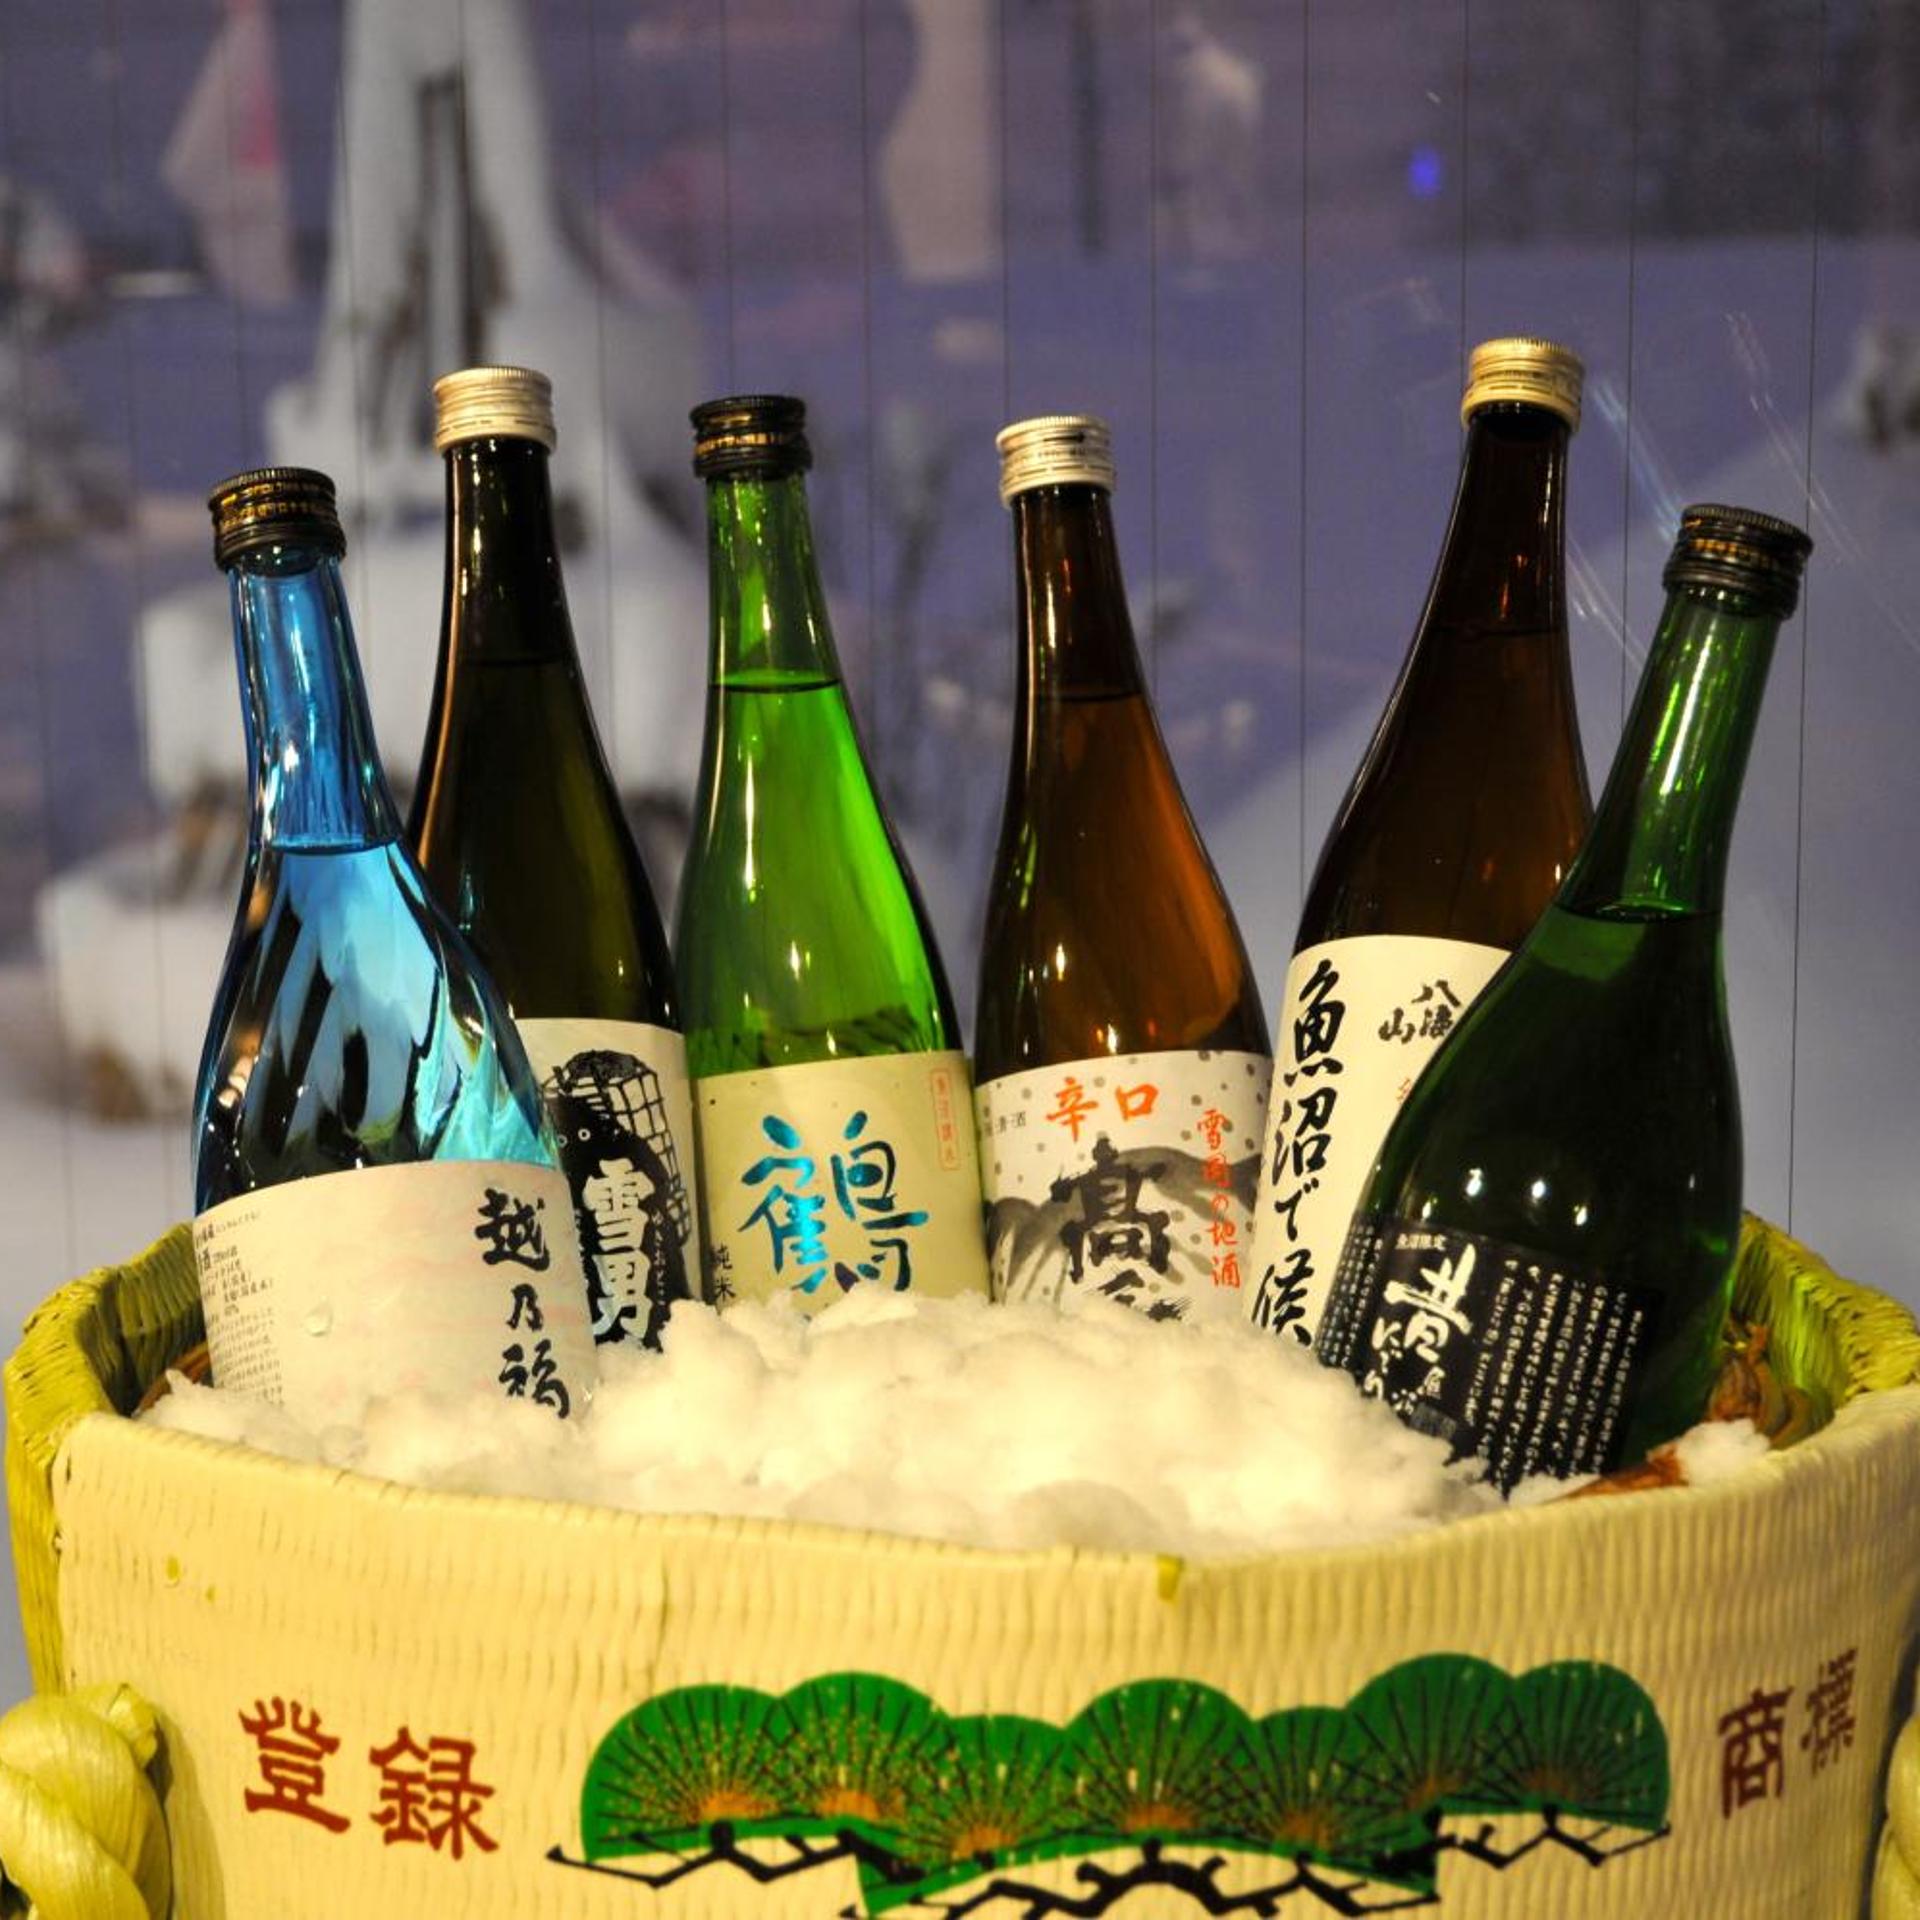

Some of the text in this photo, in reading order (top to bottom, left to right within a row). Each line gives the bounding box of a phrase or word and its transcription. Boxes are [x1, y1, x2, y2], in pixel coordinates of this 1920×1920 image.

[1046, 1076, 1160, 1142] 辛口
[582, 1157, 656, 1339] 雪男
[737, 1110, 930, 1294] 鶴
[475, 1187, 570, 1419] 越乃福
[238, 1695, 499, 1861] 登録
